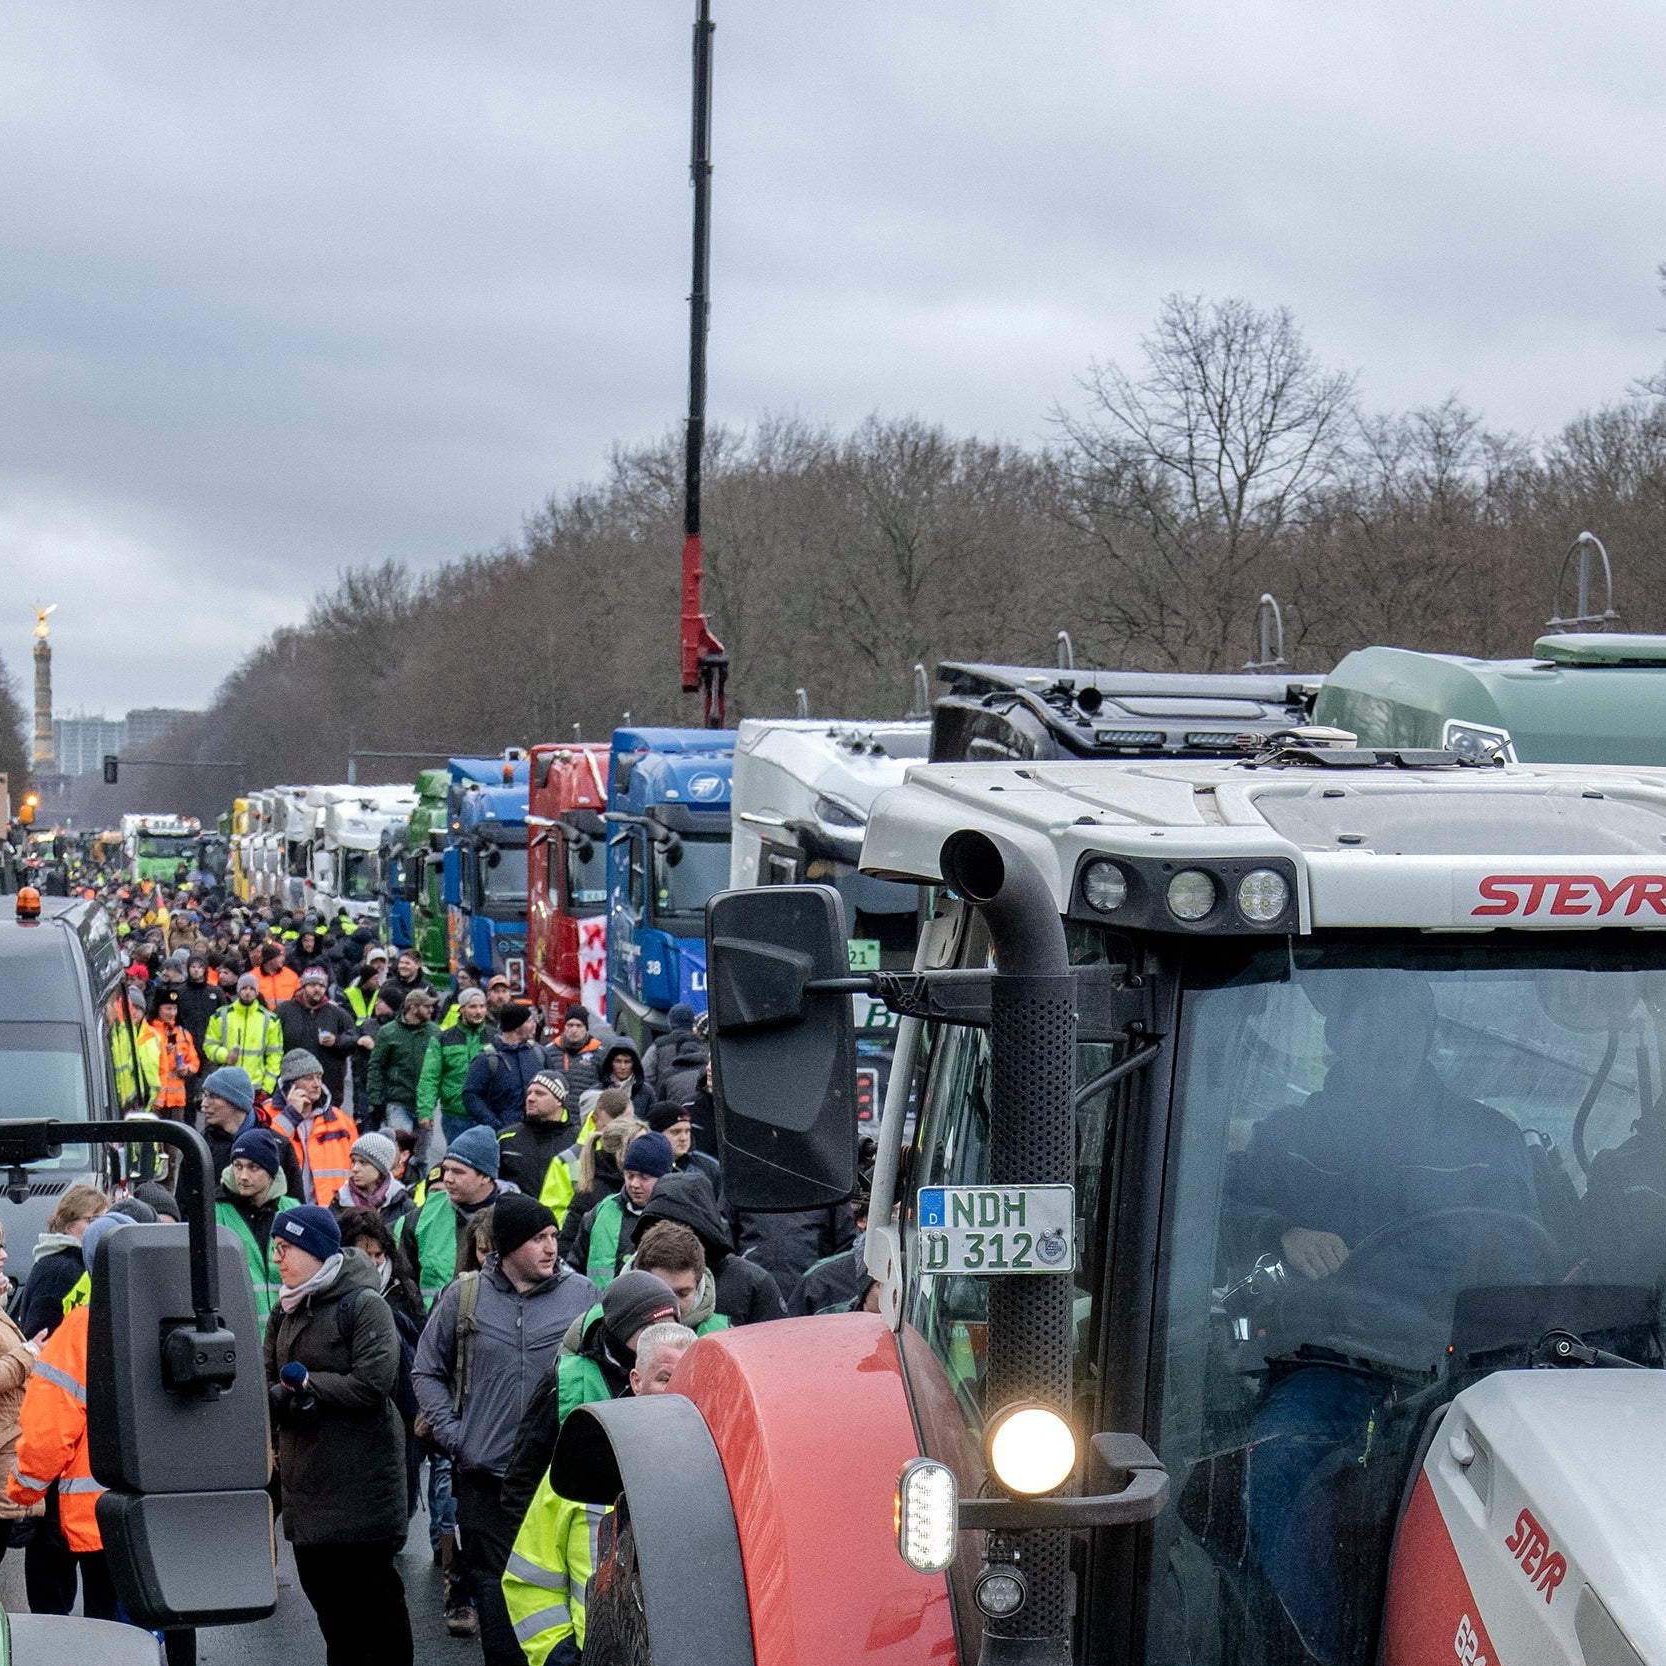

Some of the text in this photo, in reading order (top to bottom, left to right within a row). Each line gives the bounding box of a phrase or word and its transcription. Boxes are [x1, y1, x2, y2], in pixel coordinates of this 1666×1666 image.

[646, 960, 662, 976] 38
[929, 1192, 1026, 1228] D NDH
[927, 1232, 1033, 1269] D 312
[1505, 1507, 1566, 1605] STEYR
